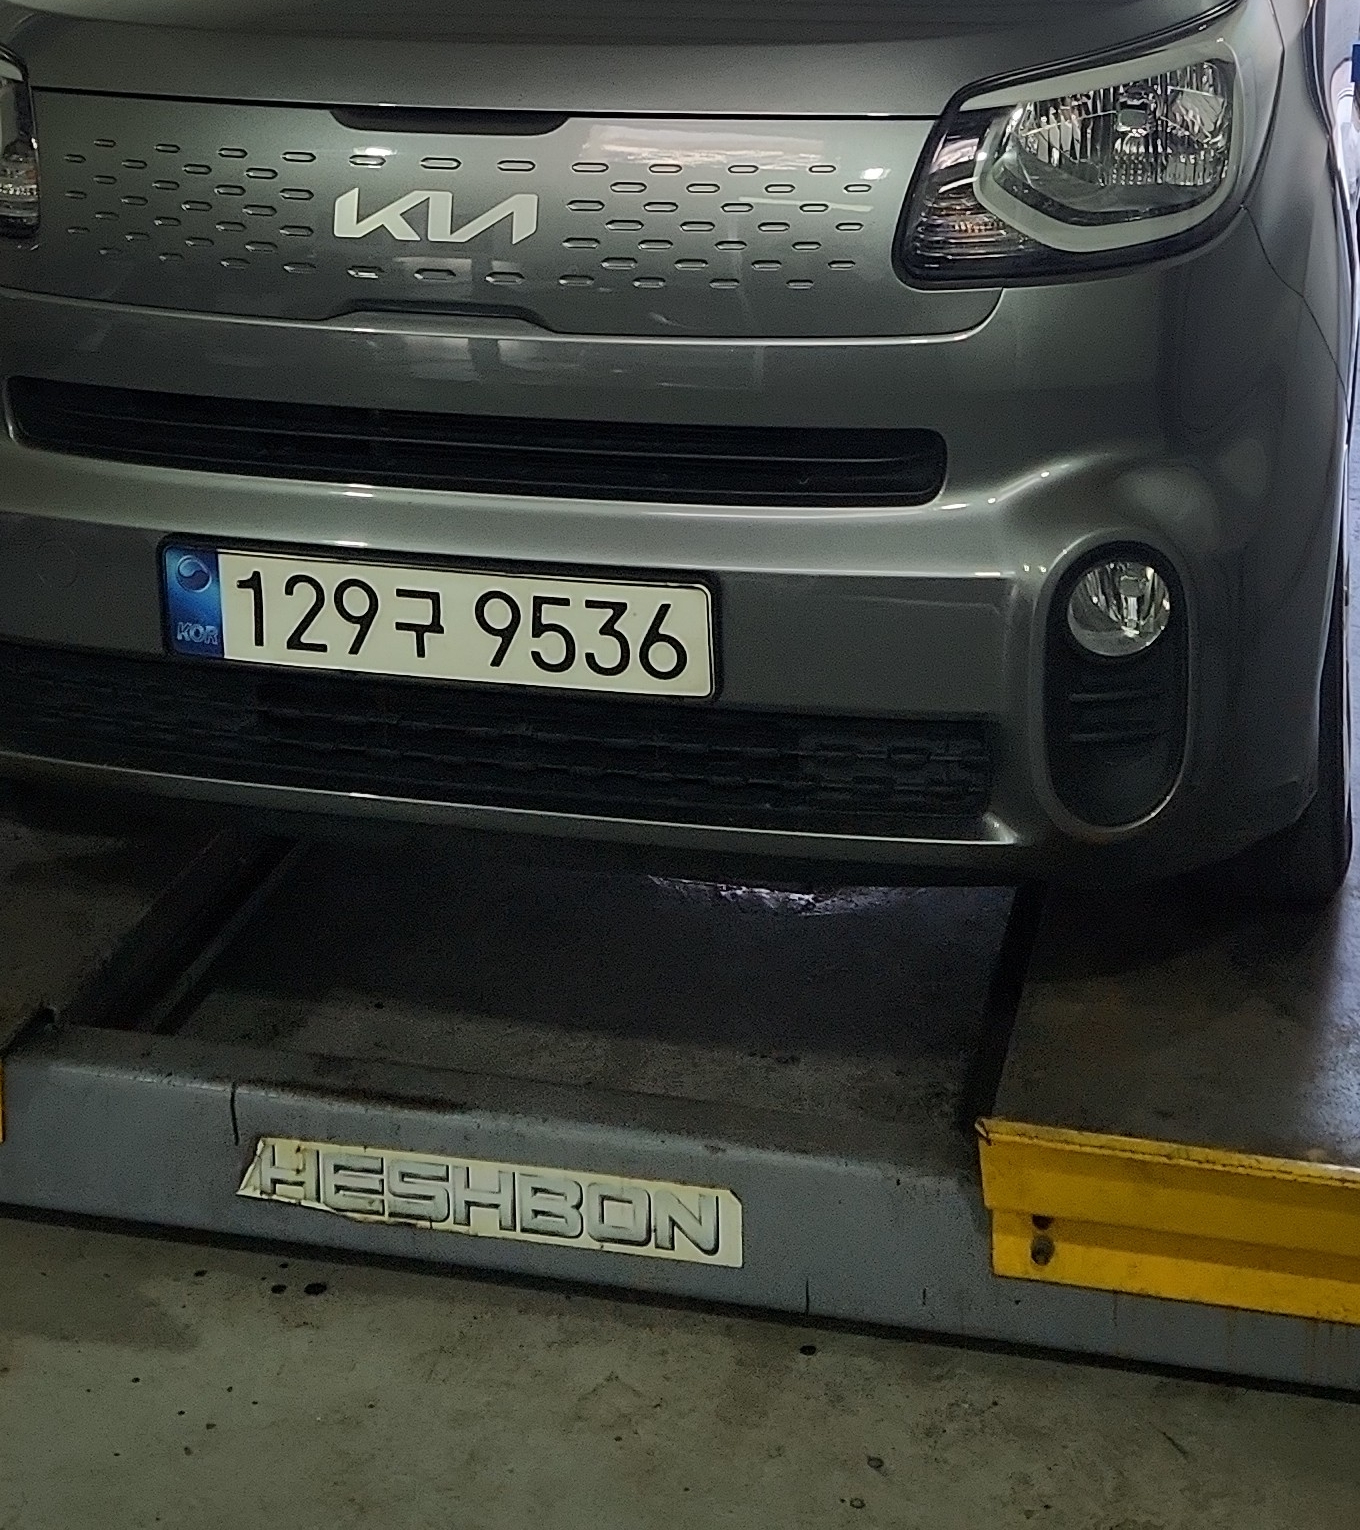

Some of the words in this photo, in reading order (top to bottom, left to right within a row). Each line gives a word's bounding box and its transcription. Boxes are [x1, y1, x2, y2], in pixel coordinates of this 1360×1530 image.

[333, 186, 539, 245] KIA
[177, 621, 219, 645] KOR
[236, 570, 445, 659] 129구
[474, 590, 688, 681] 9536
[258, 1143, 720, 1257] HESHBON
